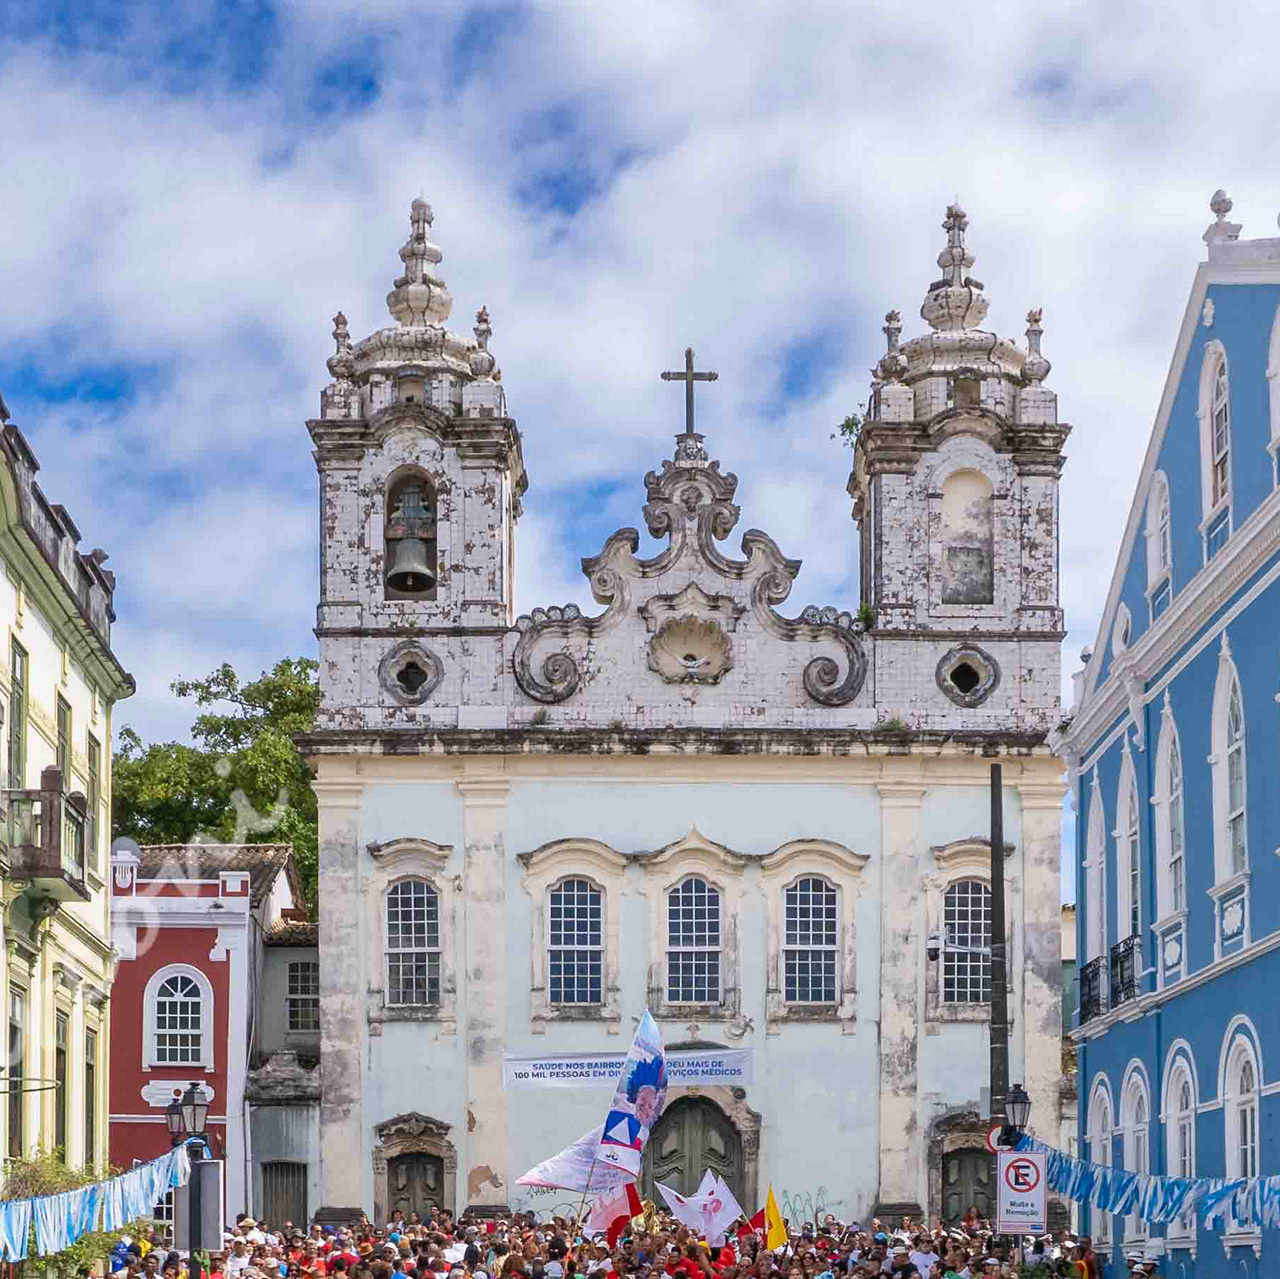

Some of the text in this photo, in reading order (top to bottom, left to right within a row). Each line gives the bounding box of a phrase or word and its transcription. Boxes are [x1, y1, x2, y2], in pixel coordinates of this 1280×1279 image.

[532, 1062, 564, 1071] SAÚDE
[587, 1061, 625, 1069] BAIRRO
[666, 1061, 684, 1069] DEU
[687, 1060, 709, 1068] MAIS
[549, 1070, 590, 1078] PESSOAS
[667, 1069, 699, 1077] RVIÇOS
[701, 1067, 742, 1076] MÉDICOS
[1005, 1209, 1039, 1217] Remoção
